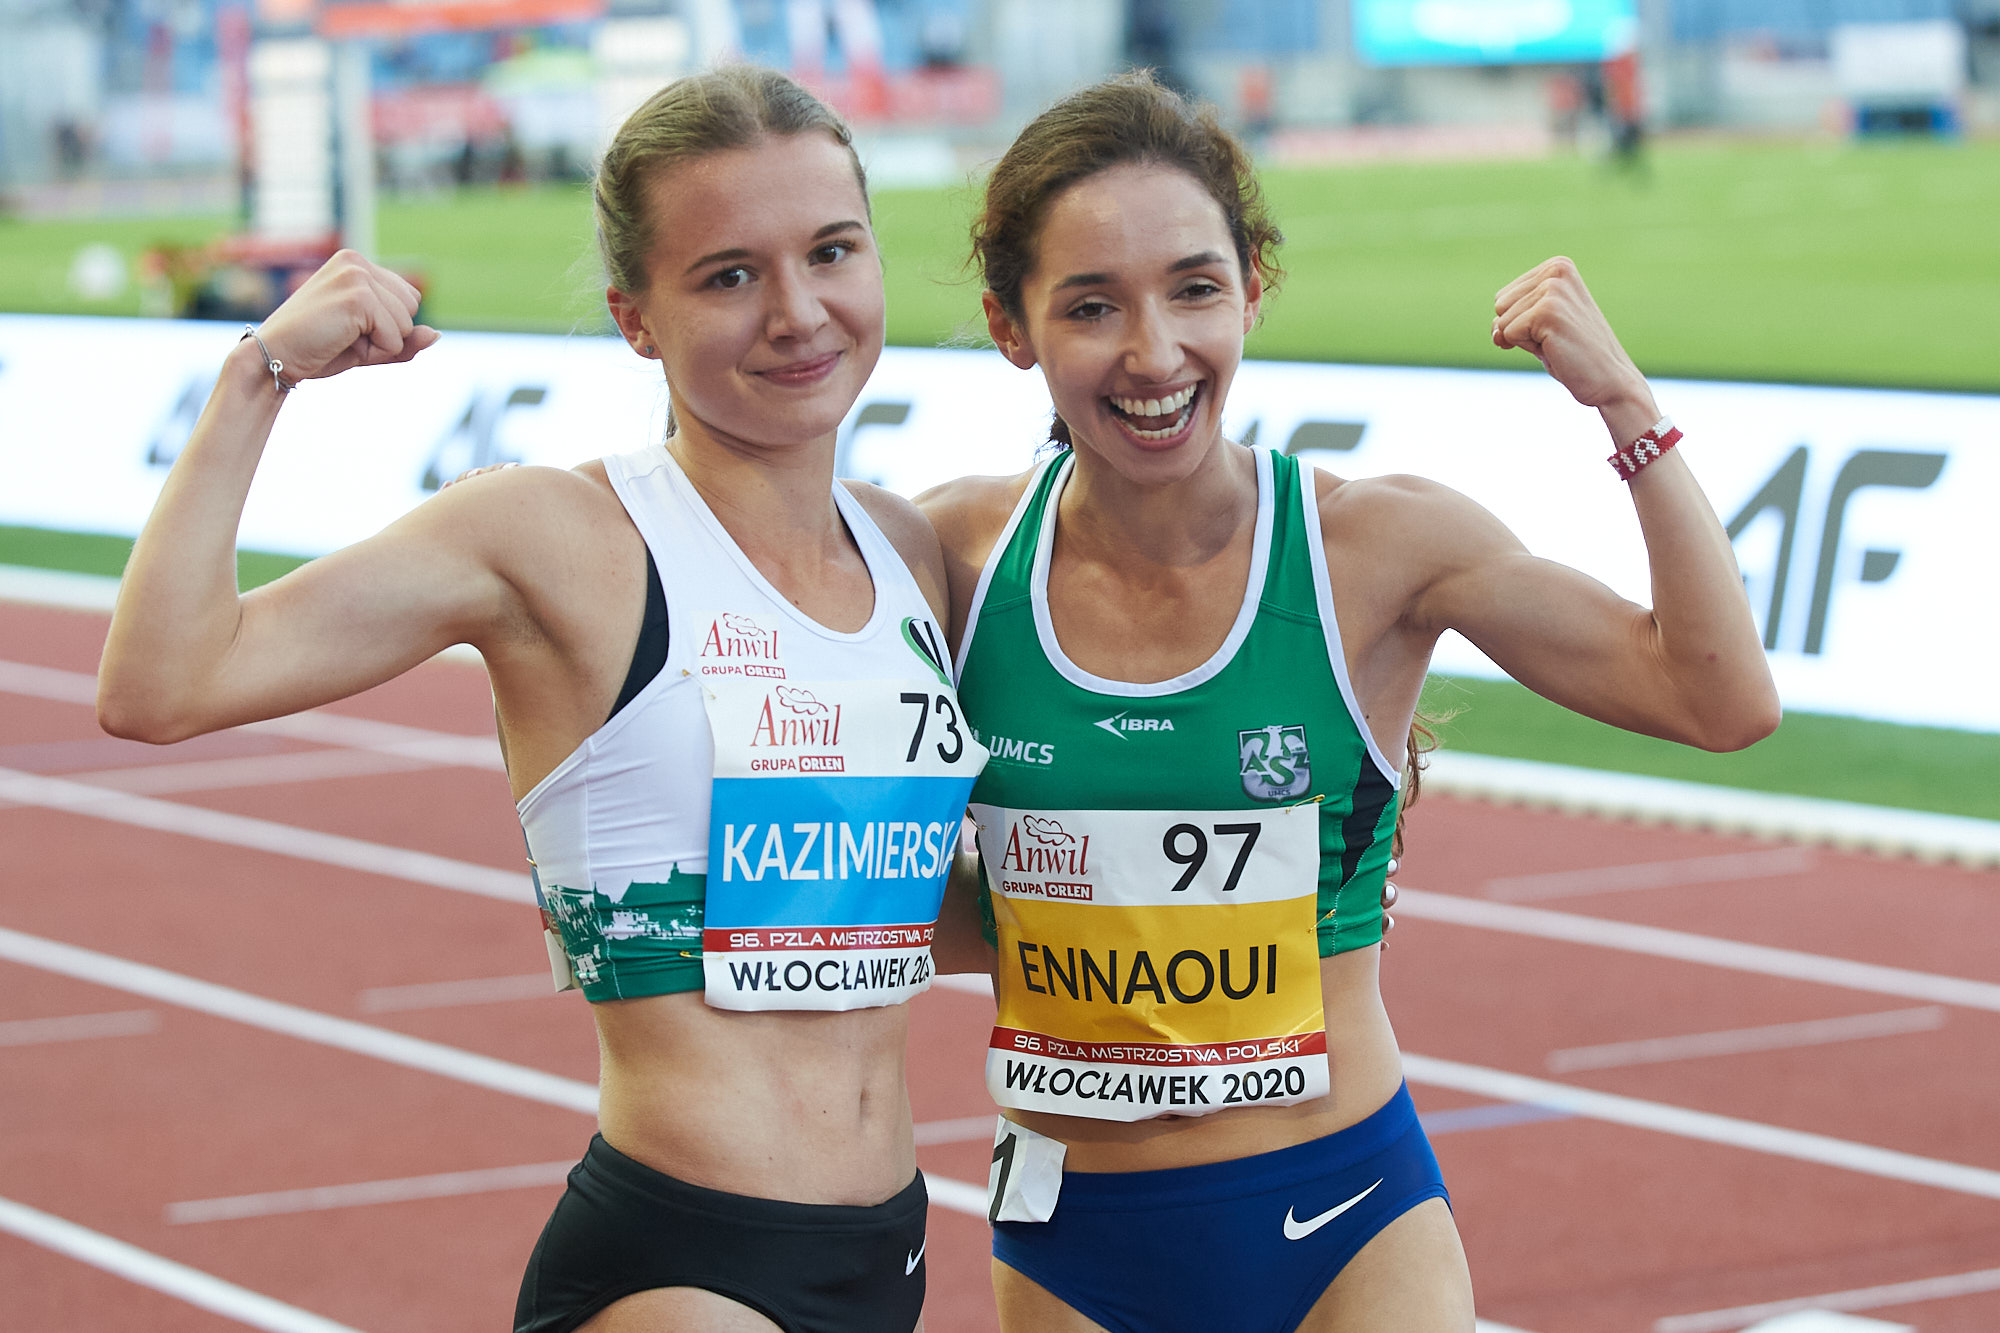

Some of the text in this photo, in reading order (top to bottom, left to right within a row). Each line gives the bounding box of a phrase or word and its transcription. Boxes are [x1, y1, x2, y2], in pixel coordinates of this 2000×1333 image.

[700, 619, 779, 660] Anwil
[701, 666, 784, 678] GRUPA ORLEN
[749, 692, 963, 763] Anwil 73
[751, 757, 843, 771] GRUPA ORLEN
[989, 735, 1055, 765] UMCS
[1000, 821, 1261, 891] Anwil 97
[1002, 880, 1090, 899] GRUPA ORLEN
[730, 933, 764, 947] 96.
[769, 932, 825, 947] PZLA
[829, 929, 922, 946] MISTRZOSTWA
[728, 957, 911, 992] WŁOCŁAWEK
[1017, 940, 1278, 1005] ENNAOUI
[1013, 1034, 1300, 1062] 96. PZLA MISTRZOSTWA POLSKI
[1005, 1059, 1306, 1106] WŁOCŁAWEK 2020
